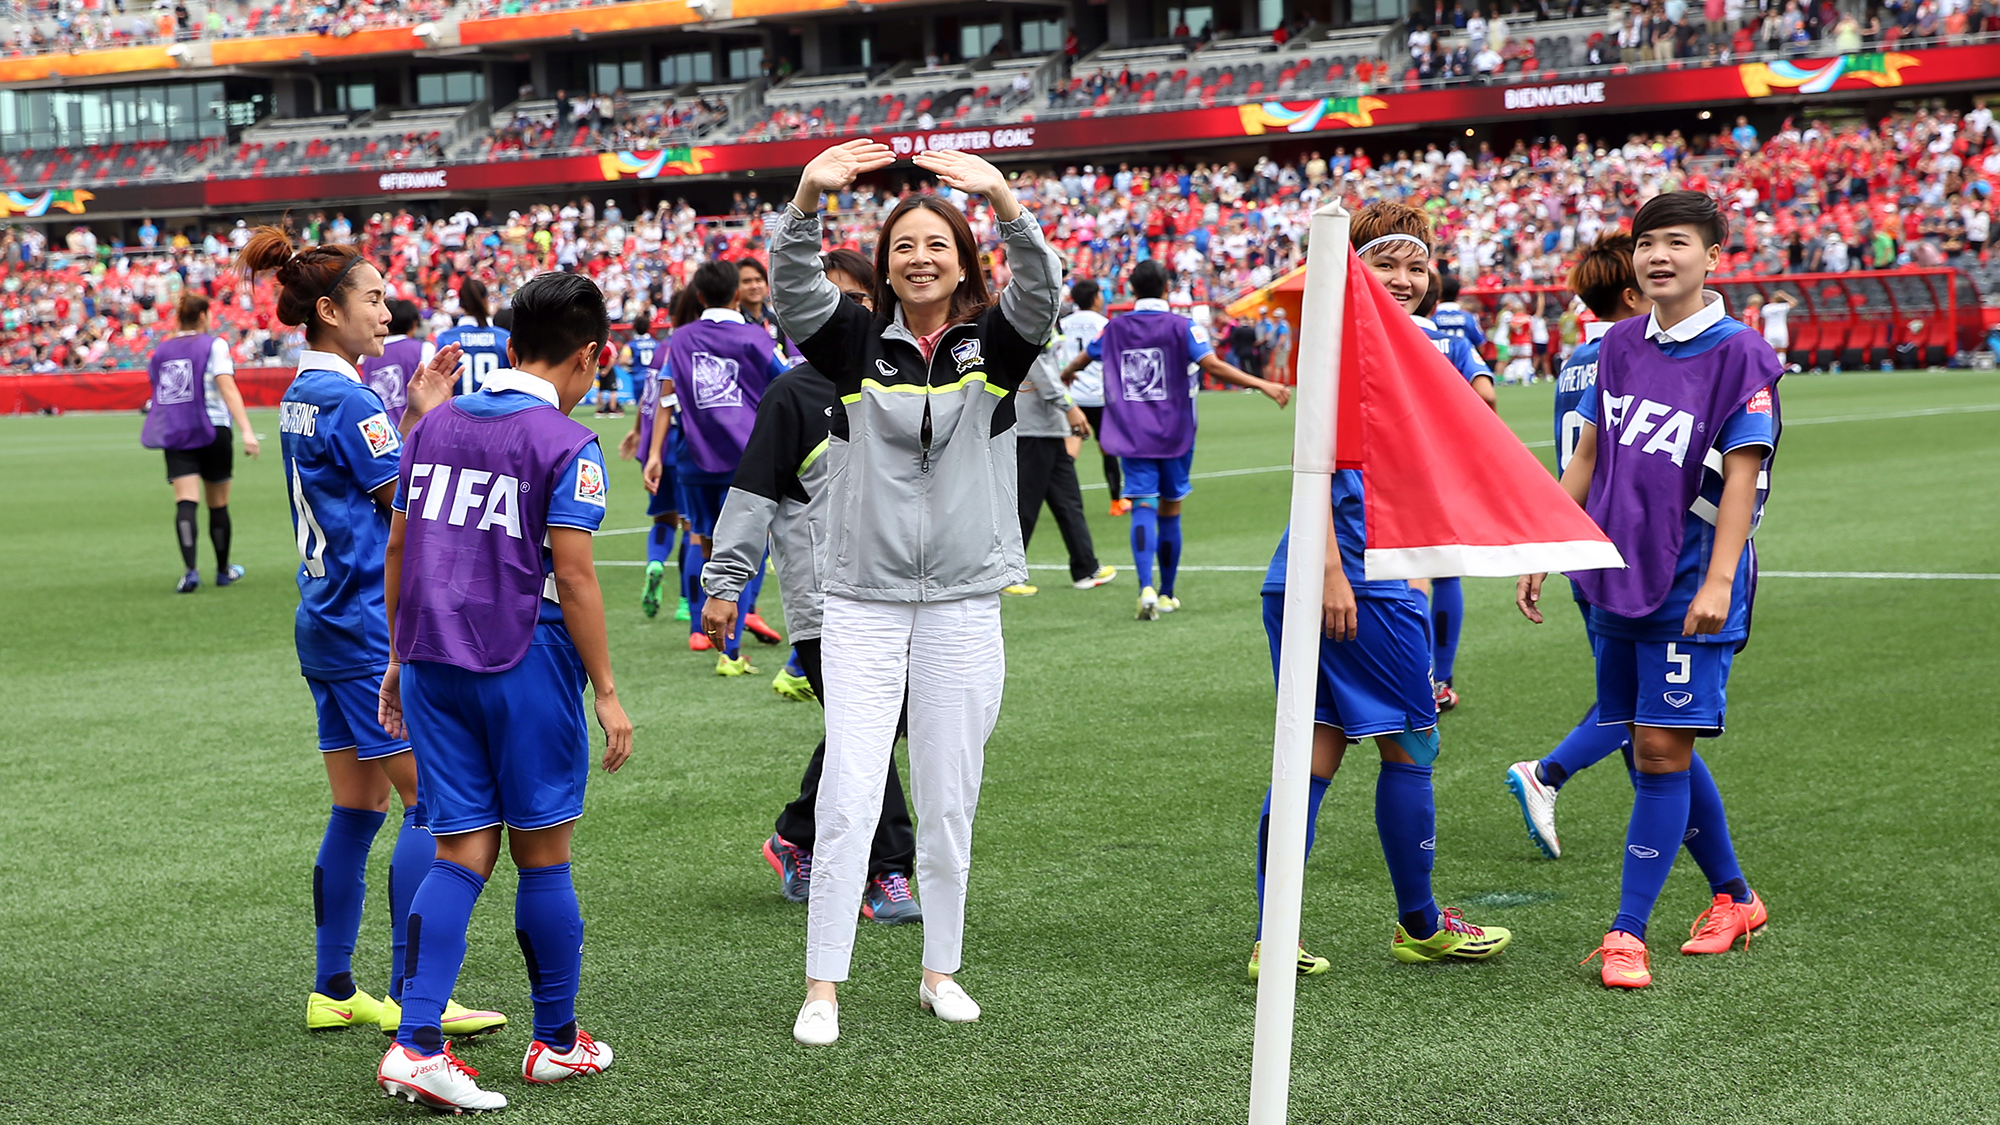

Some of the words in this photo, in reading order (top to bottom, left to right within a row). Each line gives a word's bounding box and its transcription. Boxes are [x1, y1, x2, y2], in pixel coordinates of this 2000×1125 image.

[1504, 81, 1605, 109] BIENVENUE
[891, 136, 912, 154] TO
[914, 135, 927, 152] A
[928, 131, 991, 151] GREATER
[379, 170, 447, 190] #FIFAWWC
[1602, 389, 1695, 468] FIFA
[405, 463, 523, 539] FIFA
[1665, 642, 1691, 684] 5
[419, 1063, 439, 1075] asics
